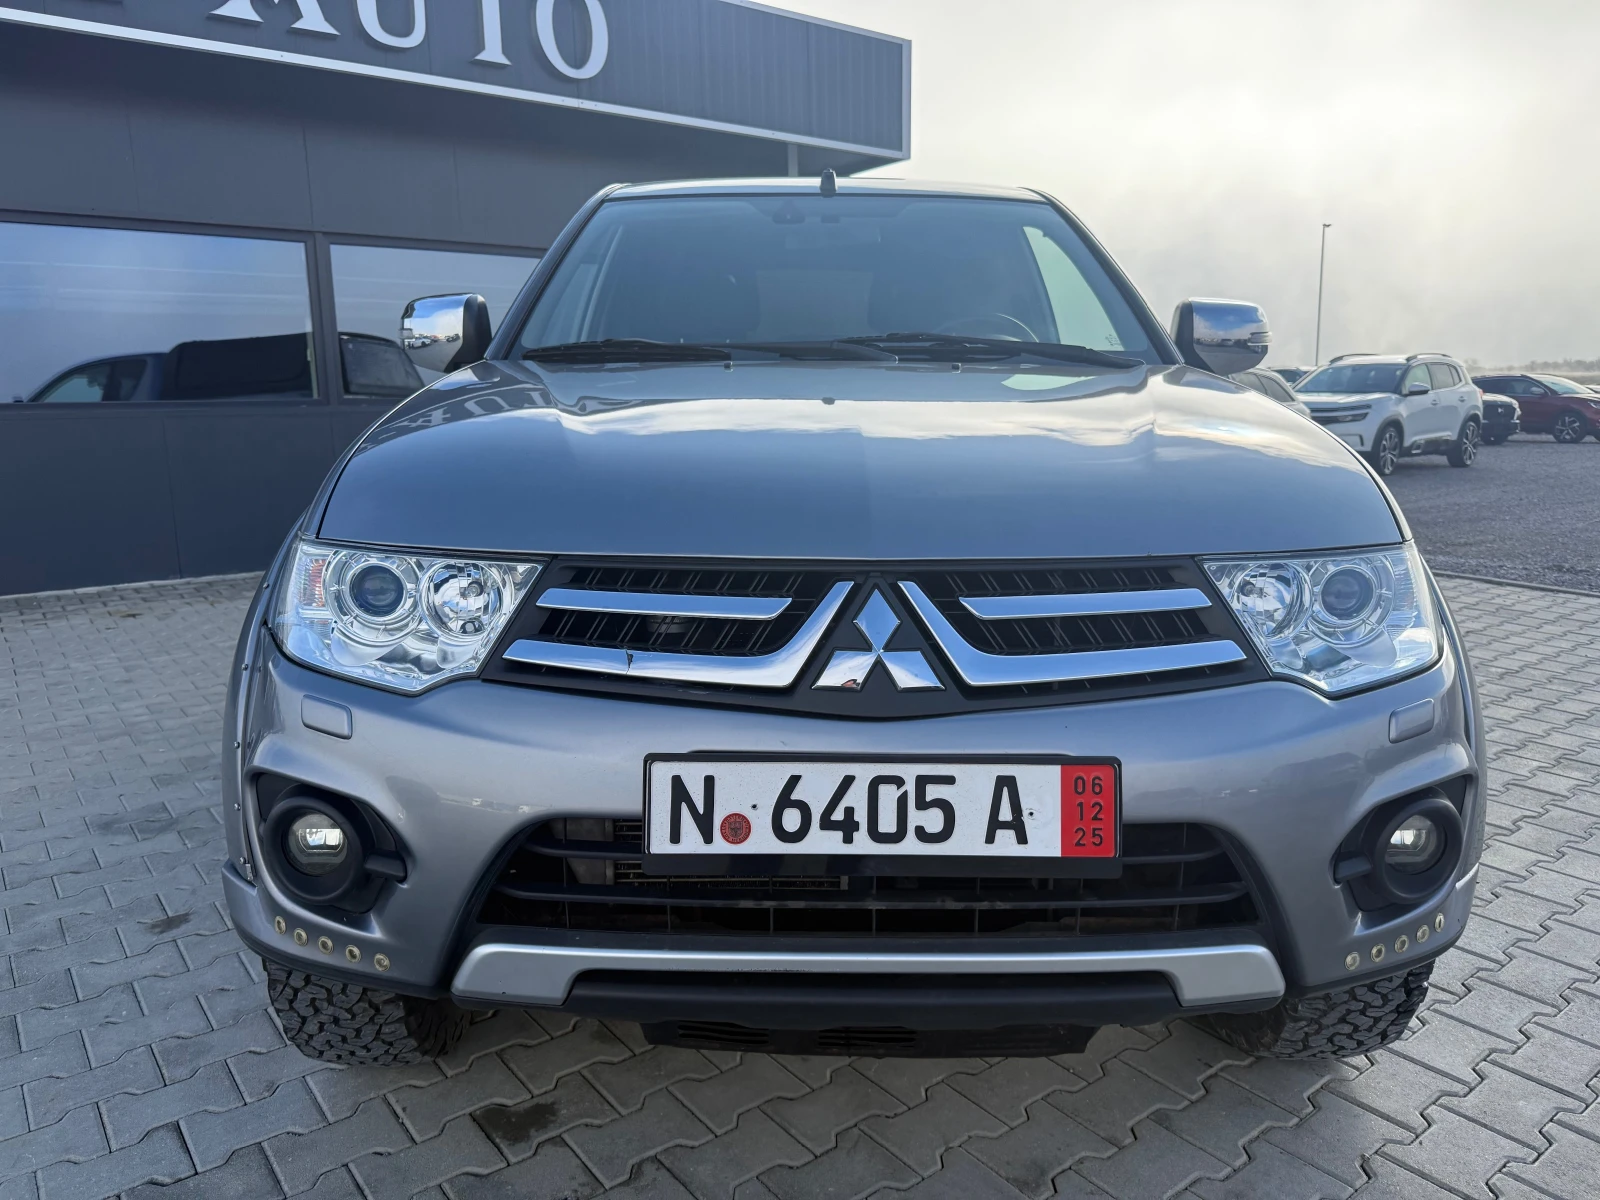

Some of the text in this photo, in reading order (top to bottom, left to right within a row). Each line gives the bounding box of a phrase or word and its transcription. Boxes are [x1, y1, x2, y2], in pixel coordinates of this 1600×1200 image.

[1073, 775, 1103, 796] 06
[669, 774, 716, 845] N
[771, 774, 957, 845] 6405
[984, 774, 1029, 845] A
[1076, 801, 1104, 821] 12
[1074, 827, 1104, 847] 25
